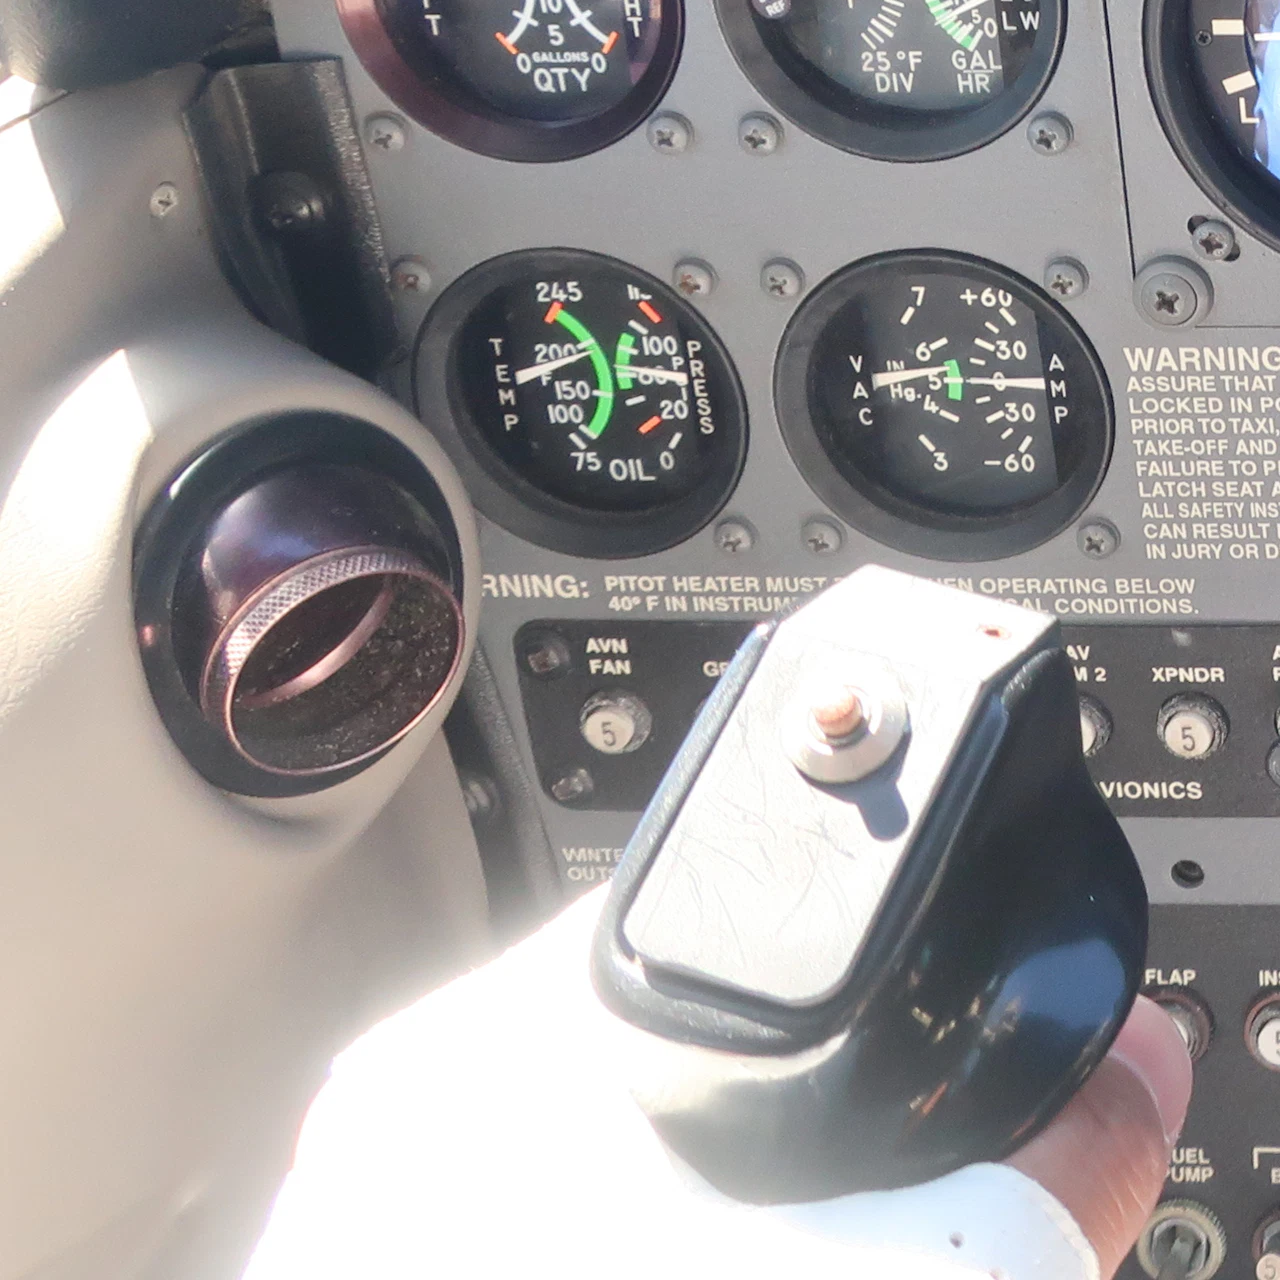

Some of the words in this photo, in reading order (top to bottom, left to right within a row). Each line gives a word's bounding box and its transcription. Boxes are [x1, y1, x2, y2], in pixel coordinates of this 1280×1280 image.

[531, 51, 590, 63] GALLONS
[533, 67, 591, 93] QTY
[874, 72, 914, 93] DIV
[535, 281, 583, 303] 245
[1128, 396, 1224, 414] LOCKED
[1230, 396, 1253, 414] IN
[609, 458, 656, 481] OIL
[1135, 460, 1225, 477] FAILURE
[1232, 460, 1257, 476] TO
[604, 575, 667, 592] PITOT
[672, 575, 760, 593] HEATER
[586, 638, 628, 654] AVN
[589, 659, 631, 675] FAN
[1151, 667, 1225, 683] XPNDR
[1144, 968, 1196, 986] FLAP
